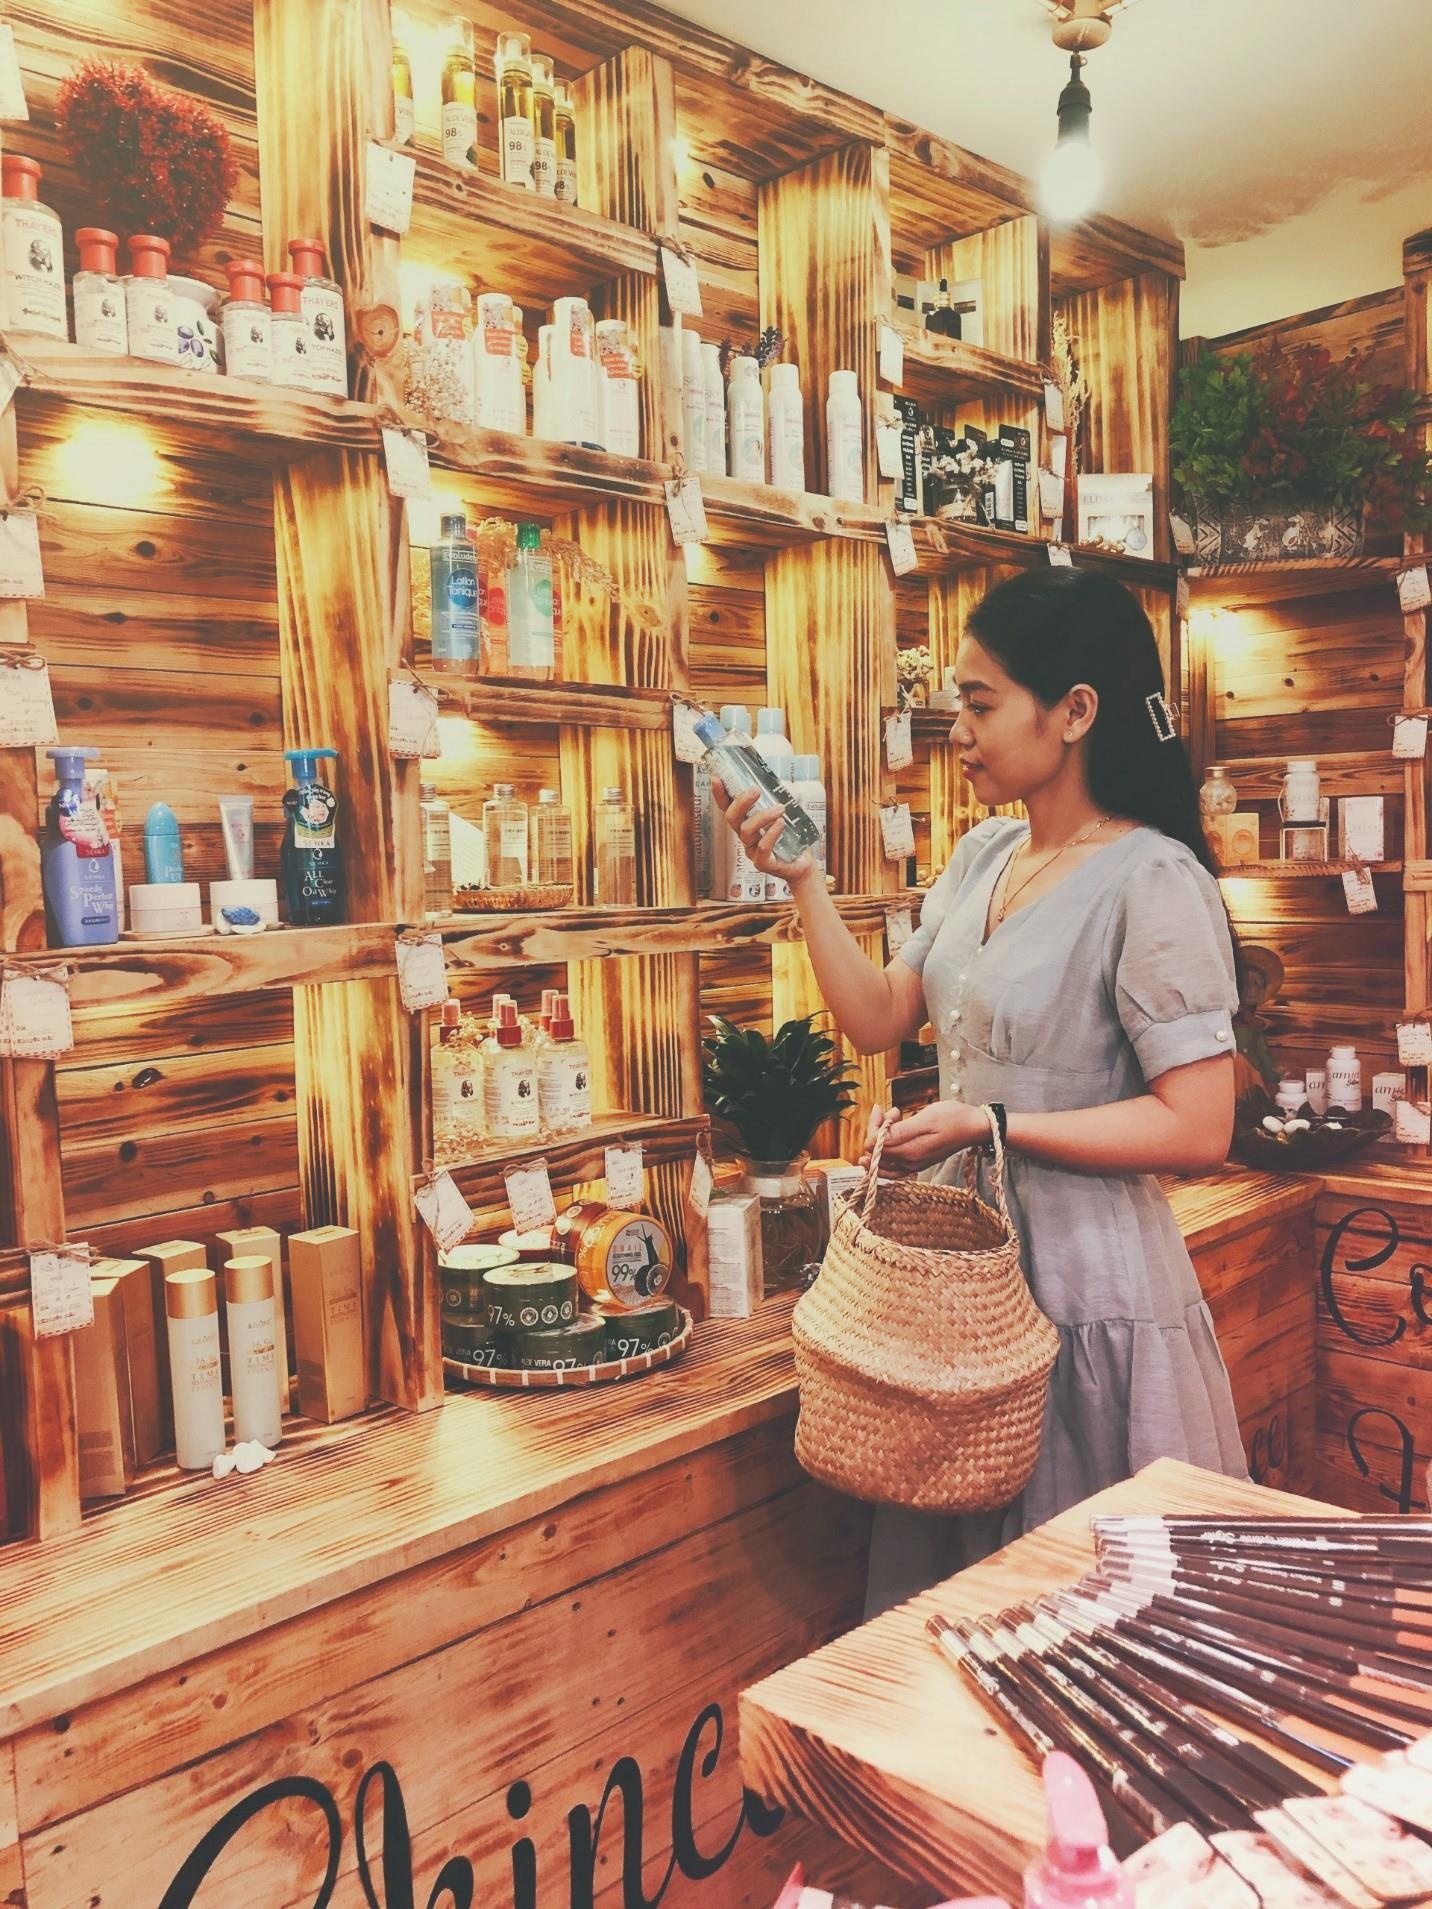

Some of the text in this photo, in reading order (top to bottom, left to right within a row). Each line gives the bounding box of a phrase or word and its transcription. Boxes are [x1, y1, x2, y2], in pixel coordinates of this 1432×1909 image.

[303, 295, 339, 310] THAYERS
[451, 576, 475, 586] Lotion
[487, 1304, 516, 1327] 97%
